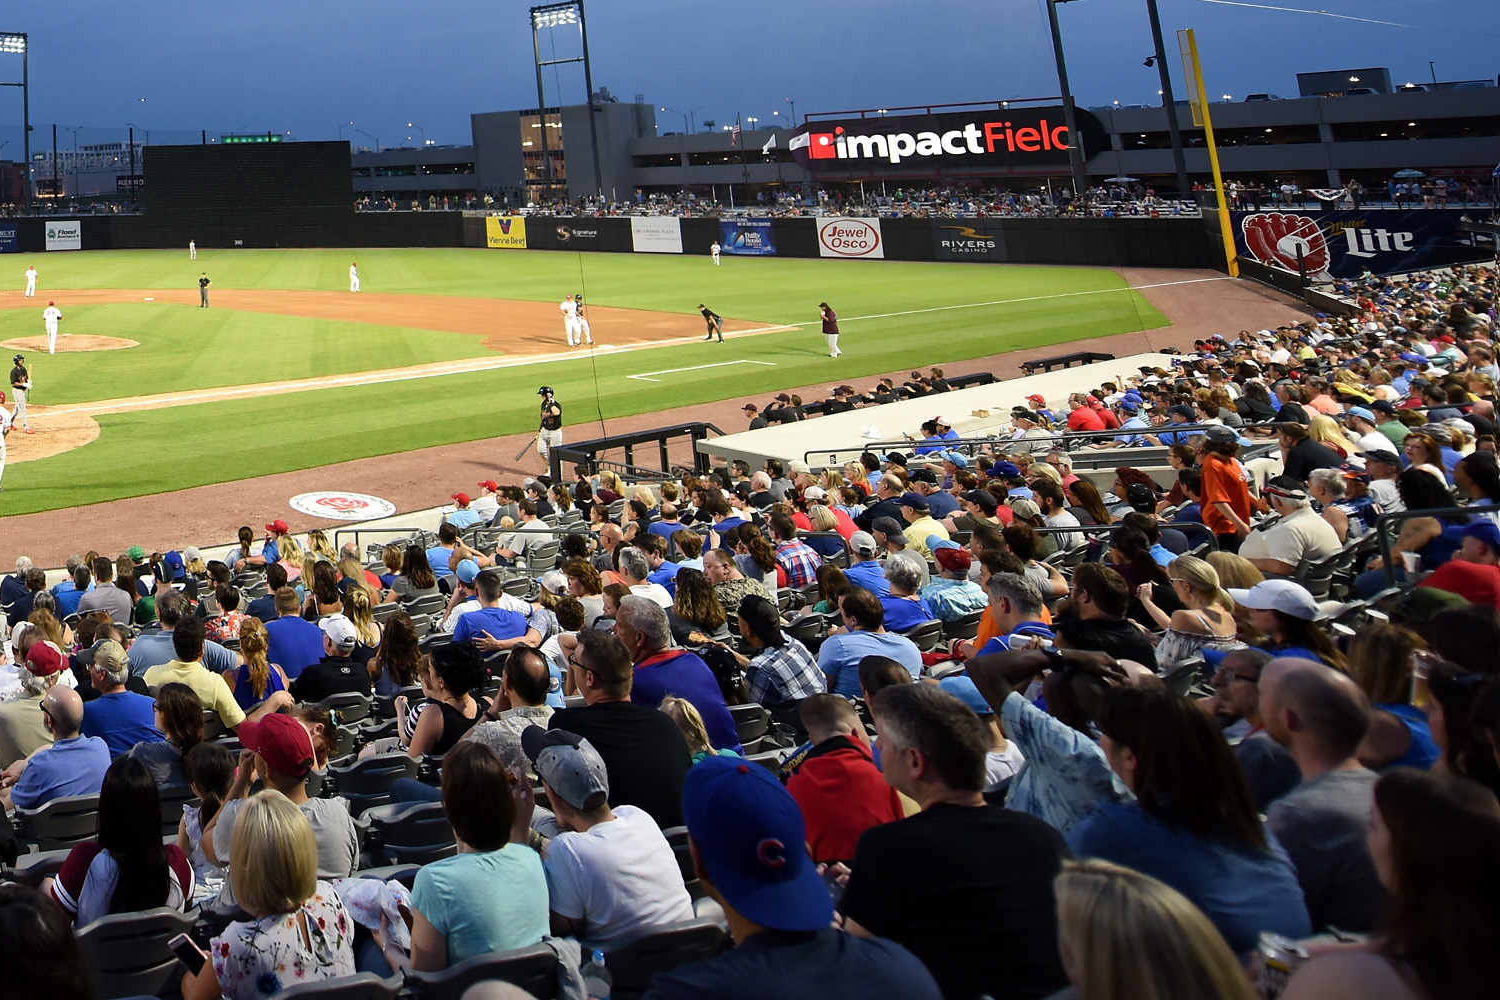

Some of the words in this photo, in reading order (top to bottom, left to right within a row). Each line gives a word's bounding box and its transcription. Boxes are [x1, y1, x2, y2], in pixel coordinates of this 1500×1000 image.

[828, 226, 868, 238] Jewel
[1322, 219, 1367, 236] Miller
[488, 236, 510, 244] Vienna
[510, 236, 525, 246] Beef
[744, 231, 761, 239] Daily
[831, 237, 868, 249] Osco
[941, 240, 996, 248] RIVERS
[1341, 227, 1414, 258] Lite
[756, 838, 787, 867] C
